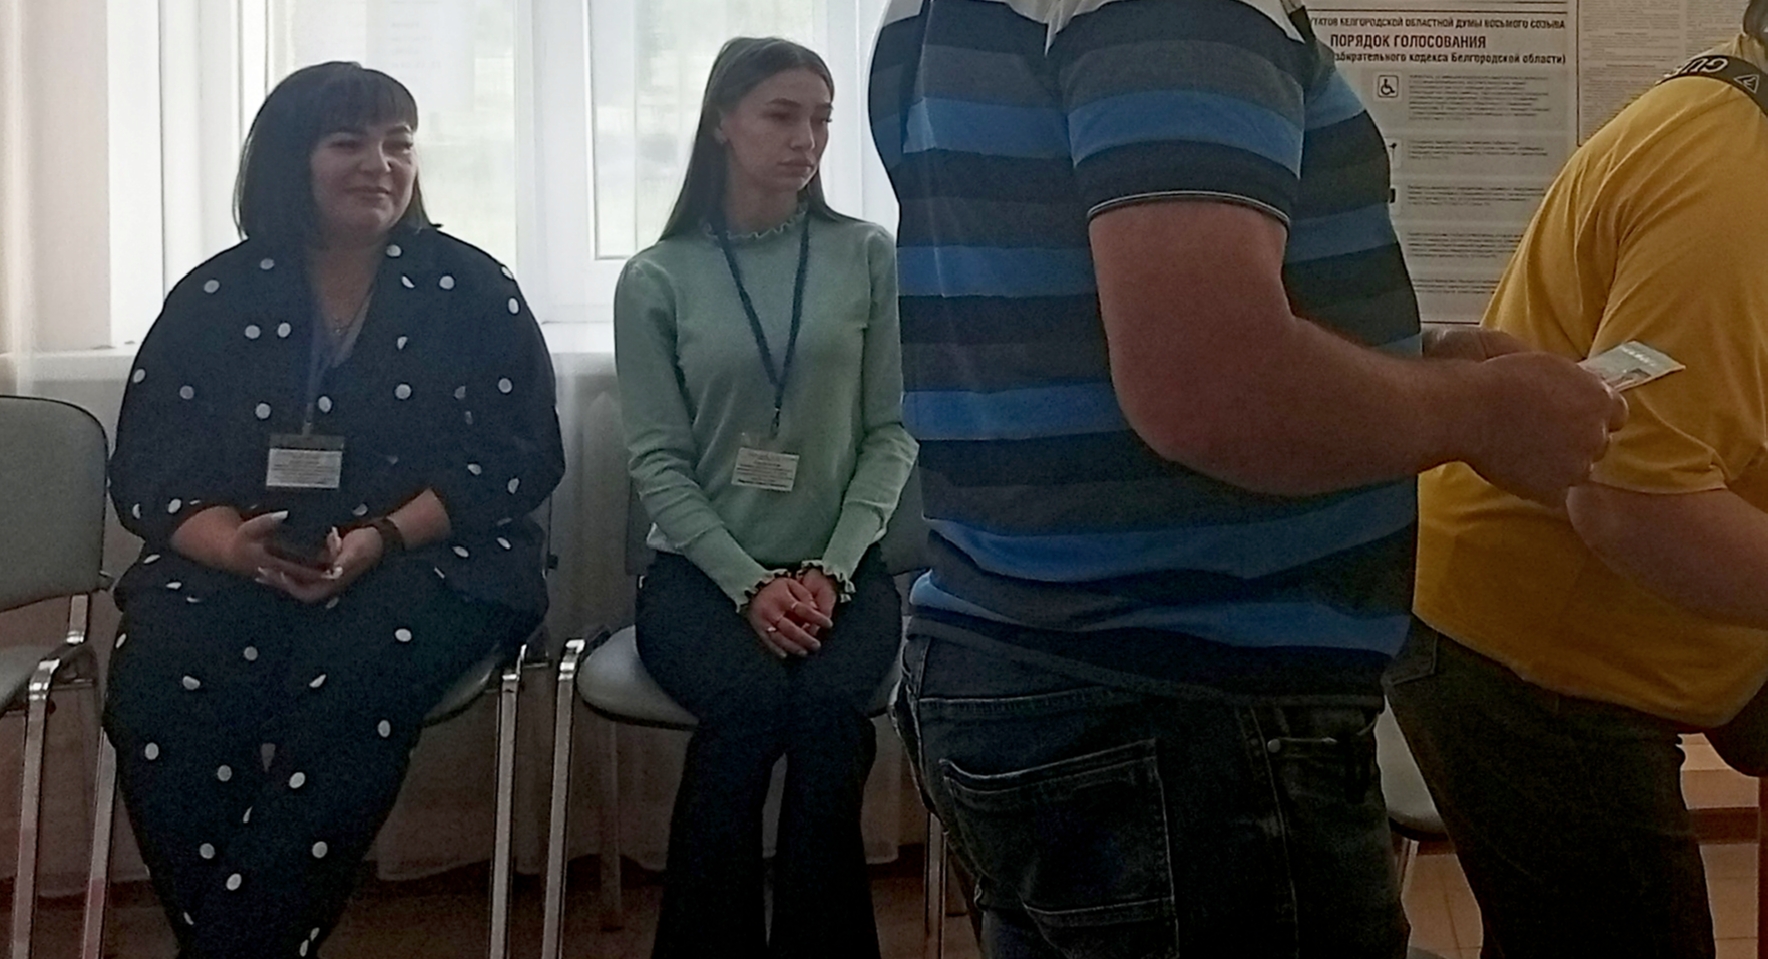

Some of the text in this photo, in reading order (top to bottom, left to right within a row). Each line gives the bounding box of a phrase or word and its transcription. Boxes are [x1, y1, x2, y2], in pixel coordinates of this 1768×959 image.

[1330, 33, 1487, 49] ПОРЯДОК ГОЛОСОВАНИЯ
[1335, 52, 1567, 65] збирательного кодекса Белгородской области)
